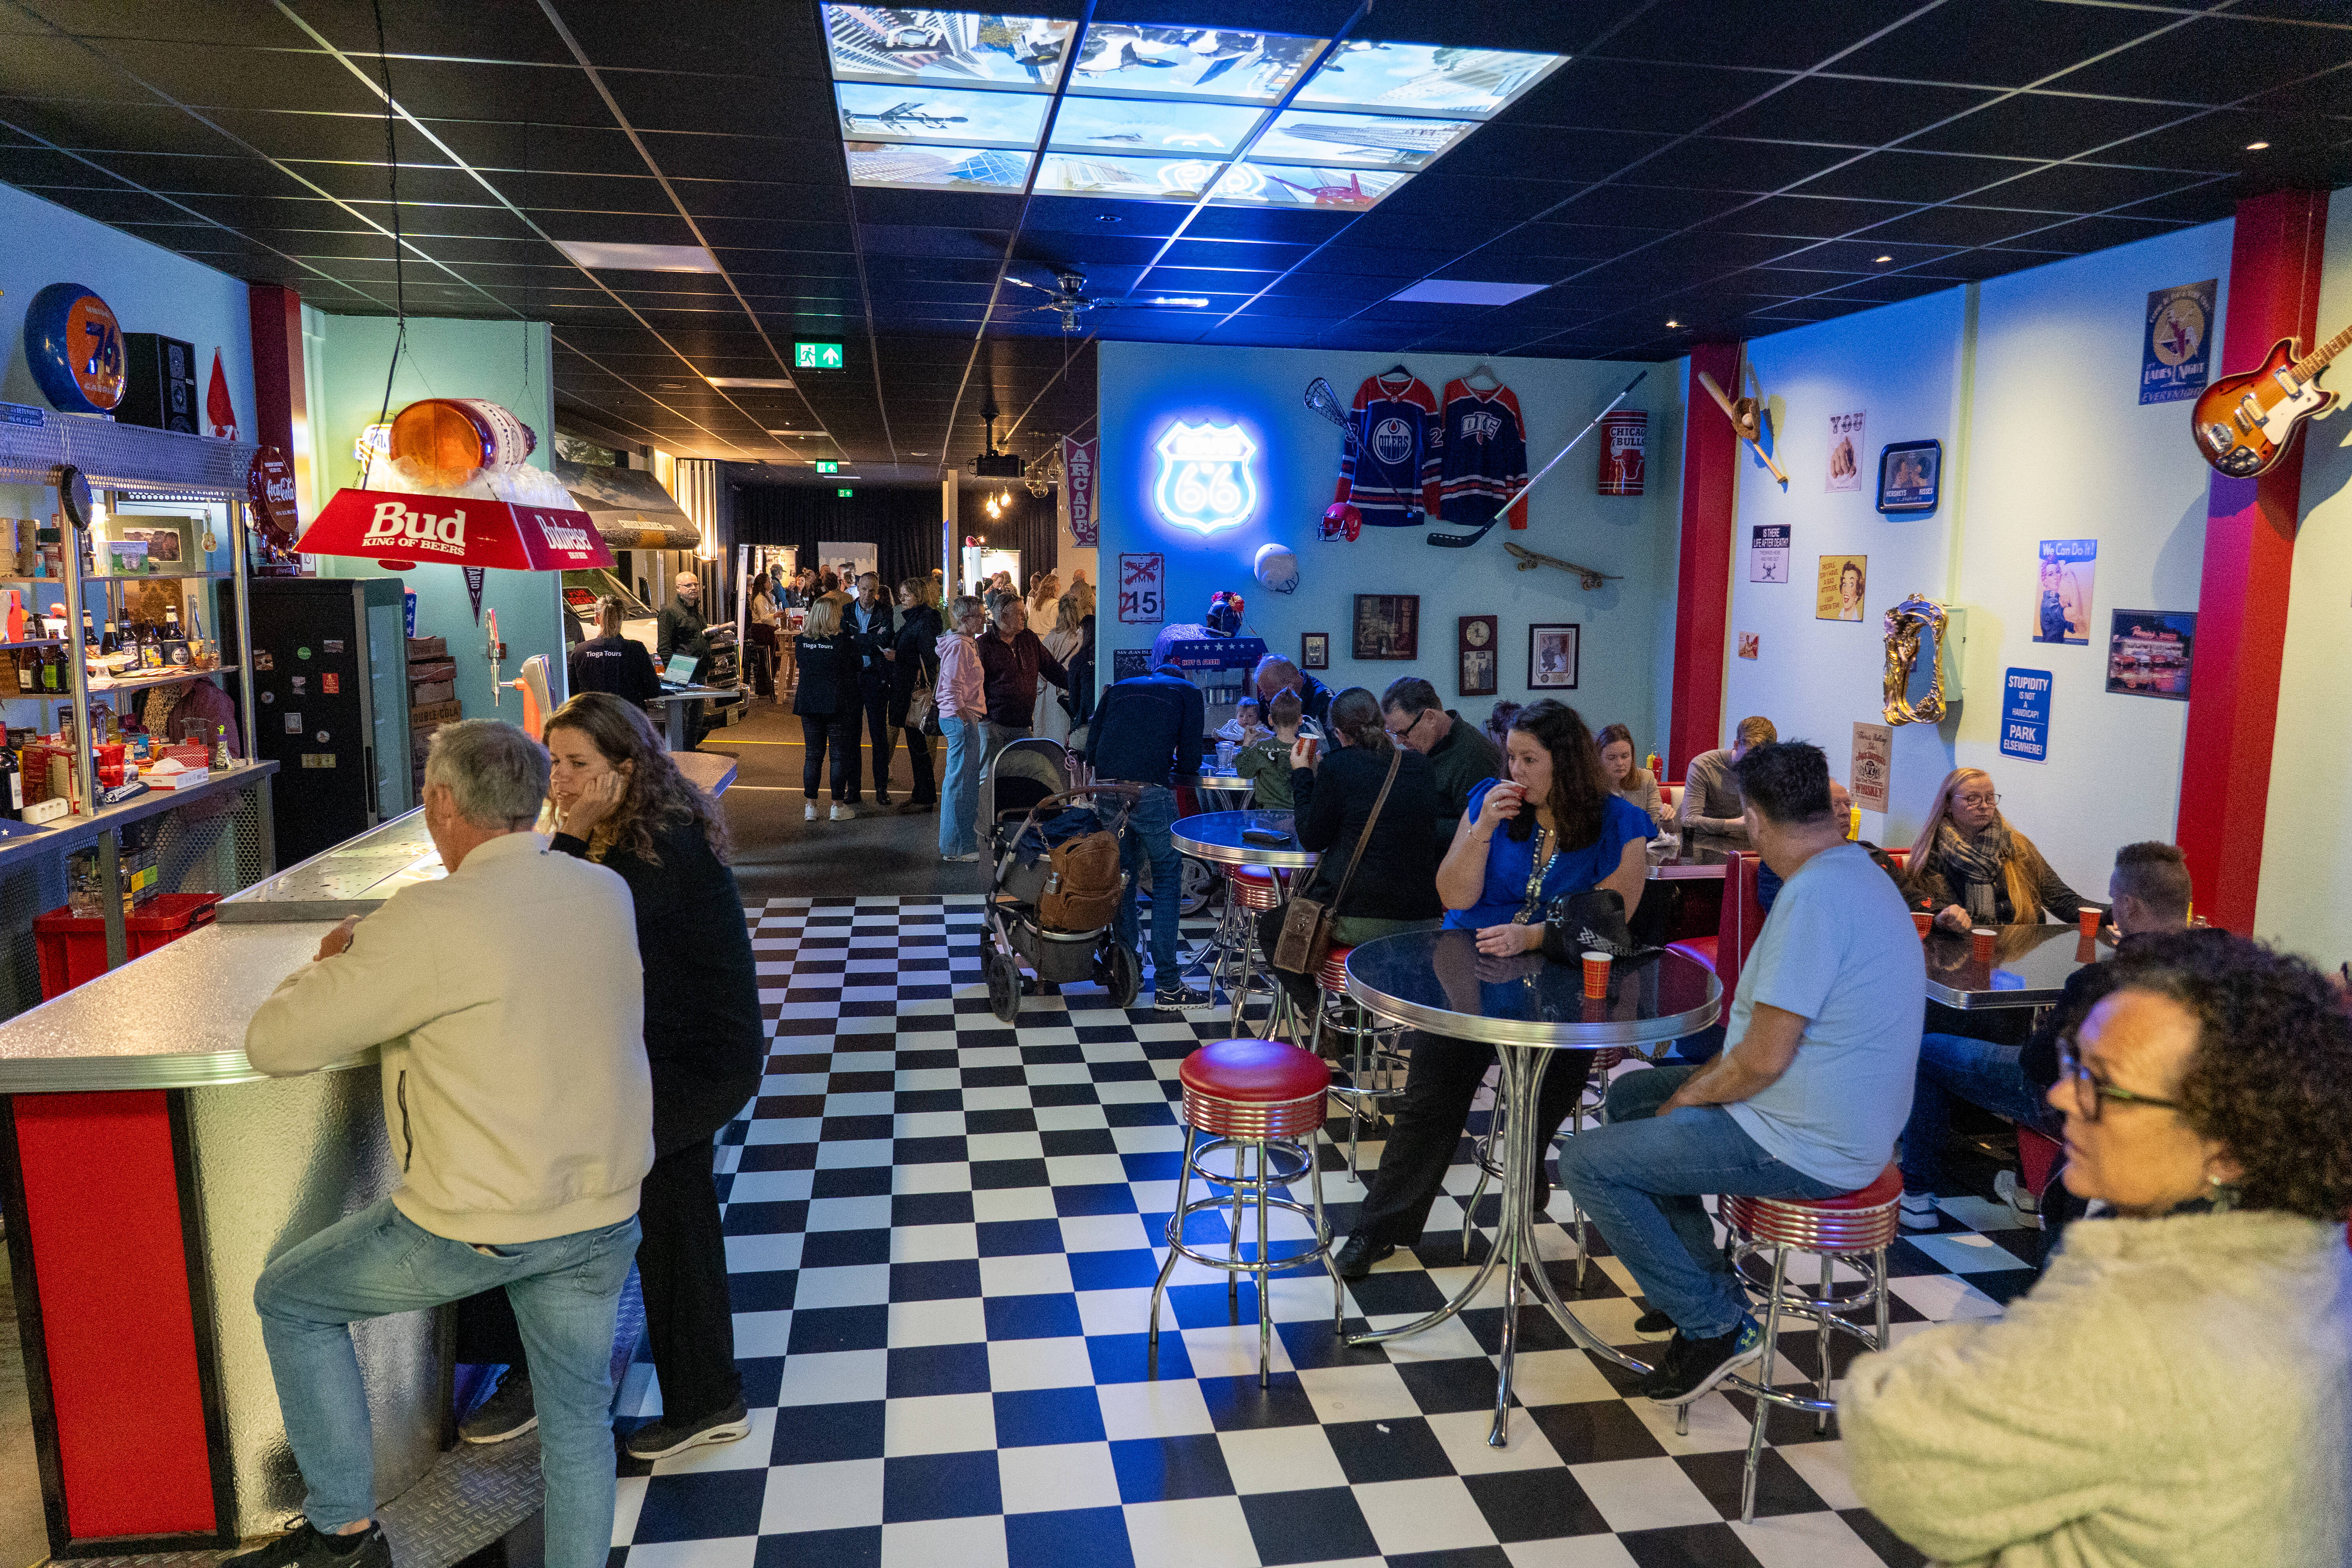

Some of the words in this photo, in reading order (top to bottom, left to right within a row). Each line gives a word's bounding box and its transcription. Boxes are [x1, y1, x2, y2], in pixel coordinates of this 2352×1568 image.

[1830, 413, 1863, 434] YOU
[1429, 427, 1443, 448] 2
[1610, 428, 1645, 436] CHICAG
[1378, 434, 1409, 447] OILERS
[1617, 437, 1644, 446] BULLS
[1070, 449, 1095, 532] ARCADE
[1174, 462, 1241, 513] 66
[364, 502, 466, 547] Bud
[534, 515, 593, 550] Budweiser
[1763, 529, 1767, 537] IS
[1768, 528, 1780, 537] THERE
[362, 537, 395, 546] KING
[398, 538, 418, 547] OF
[420, 540, 465, 556] BEERS
[1762, 538, 1773, 547] AFTER
[1774, 538, 1788, 547] DEATH?
[2043, 543, 2054, 556] We
[2056, 543, 2070, 555] Can
[2072, 543, 2083, 555] Do
[2085, 542, 2094, 555] It!
[1822, 562, 1835, 570] PEOPLE
[466, 567, 481, 590] TARIO
[1128, 575, 1156, 583] IMI
[568, 596, 597, 606] RENT
[1129, 591, 1157, 613] 15
[2008, 675, 2049, 691] STUPIDITY
[2019, 691, 2024, 699] IS
[2025, 692, 2035, 701] NOT
[414, 710, 437, 723] OUBLE
[439, 707, 458, 719] COLA
[2012, 708, 2039, 719] HANDICAP!
[2010, 724, 2036, 742] PARK
[2004, 739, 2042, 755] ELSEWHERE!
[1855, 783, 1883, 798] WHISKEY
